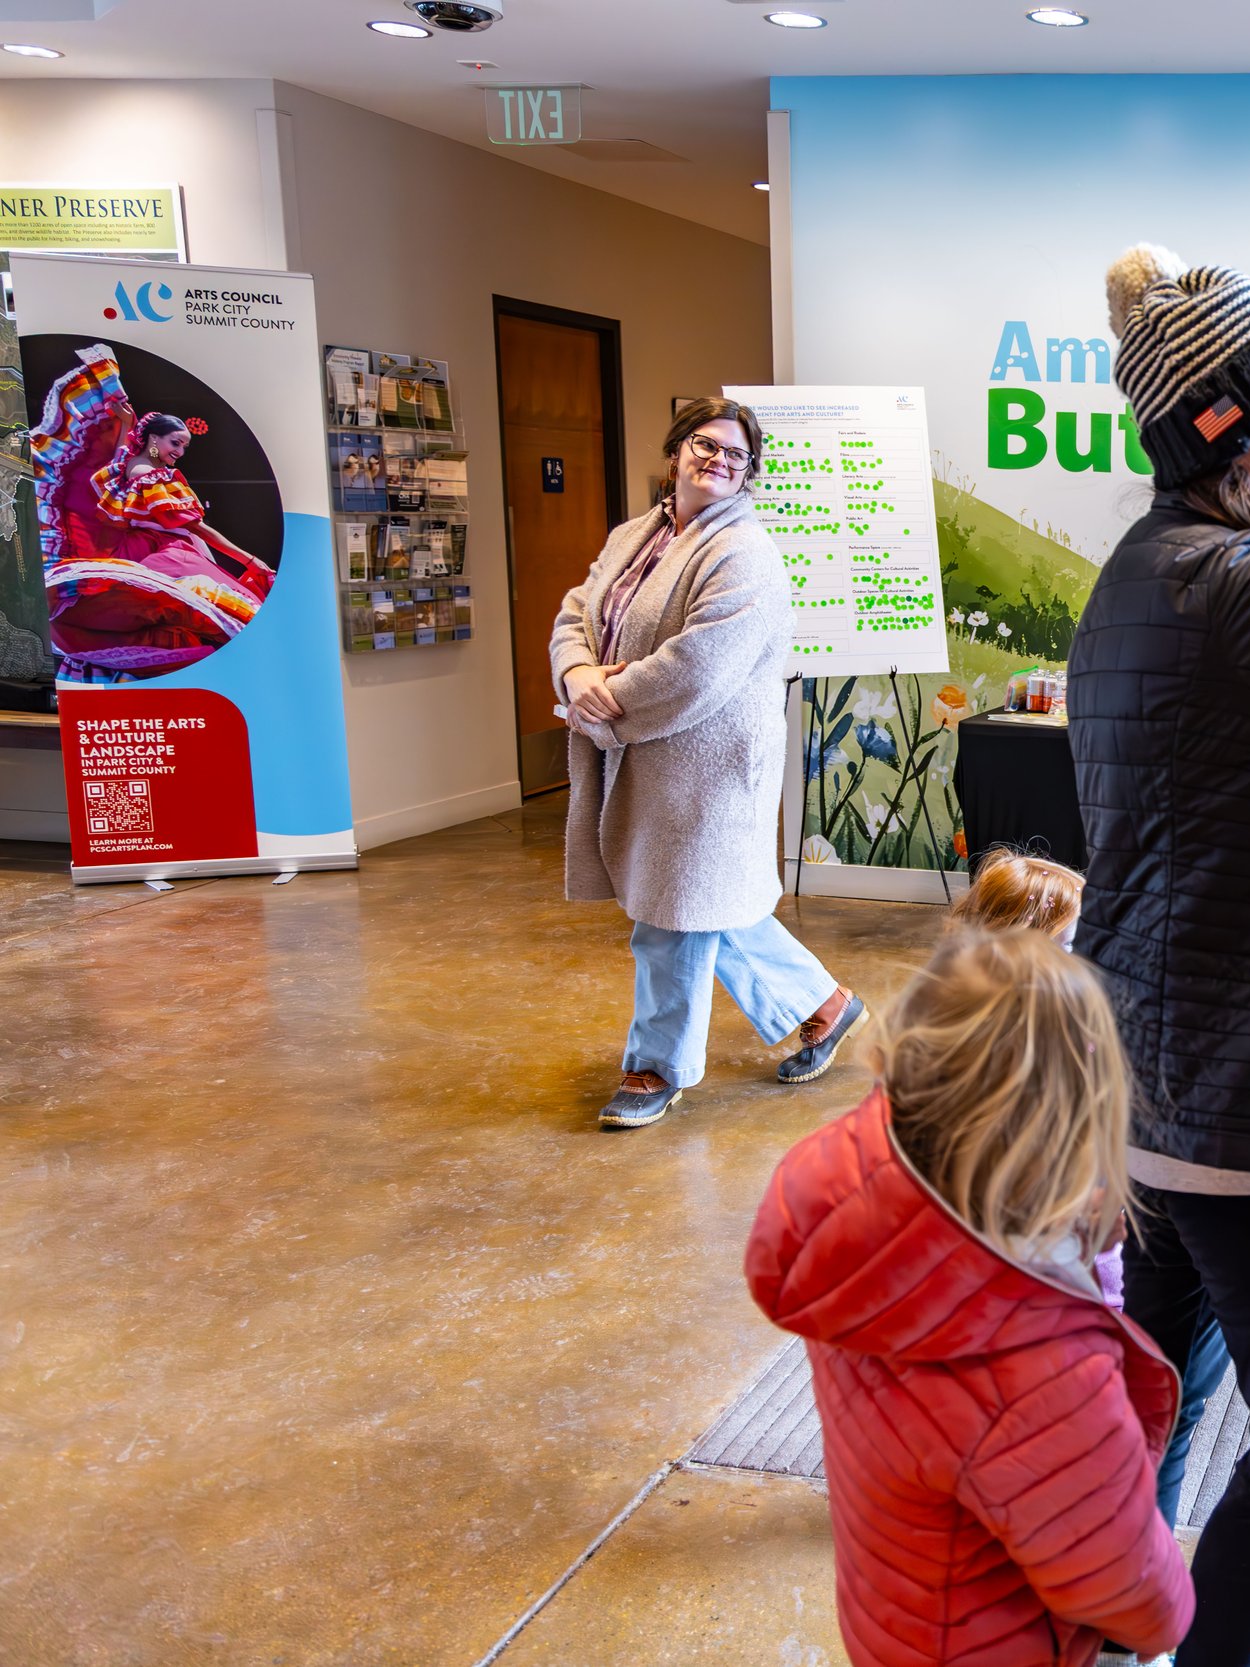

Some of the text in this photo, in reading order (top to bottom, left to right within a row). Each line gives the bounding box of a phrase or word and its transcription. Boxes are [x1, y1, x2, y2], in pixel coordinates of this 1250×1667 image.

[0, 199, 48, 217] NER
[185, 289, 283, 305] ARTS COUNCIL
[185, 301, 251, 315] PARK CITY
[186, 314, 295, 330] SUMMIT COUNTY
[77, 718, 206, 731] SHAPE THE ARTS
[79, 732, 166, 744] & CULTURE
[80, 745, 175, 758] LANDSCAPE
[81, 757, 164, 767] IN PARK CITY &
[82, 766, 176, 777] SUMMIT COUNTY
[90, 844, 174, 853] PCSCARTSPLAN.COM
